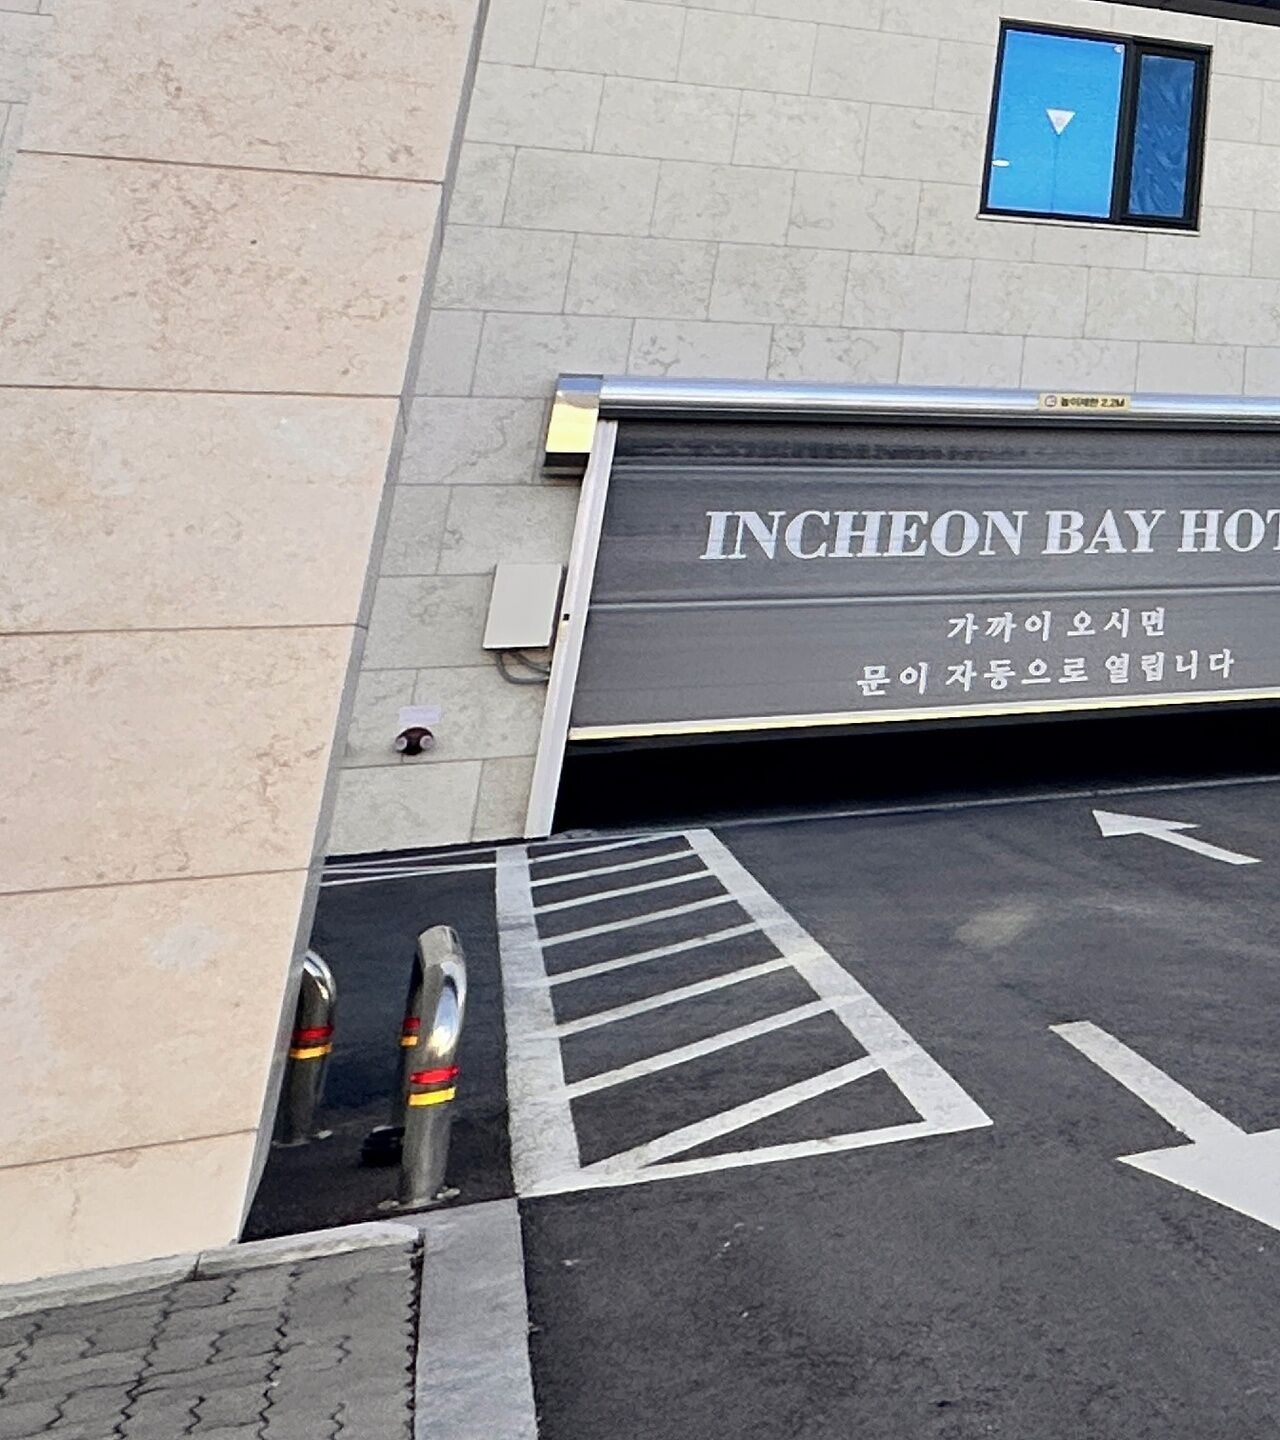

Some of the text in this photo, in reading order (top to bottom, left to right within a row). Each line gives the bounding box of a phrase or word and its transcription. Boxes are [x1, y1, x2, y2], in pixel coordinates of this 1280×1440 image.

[700, 510, 1029, 560] INCHEON
[1040, 509, 1166, 555] BAY
[947, 607, 1166, 645] 가까이 오시면
[856, 648, 1236, 696] 문이 자동으로 열립니다
